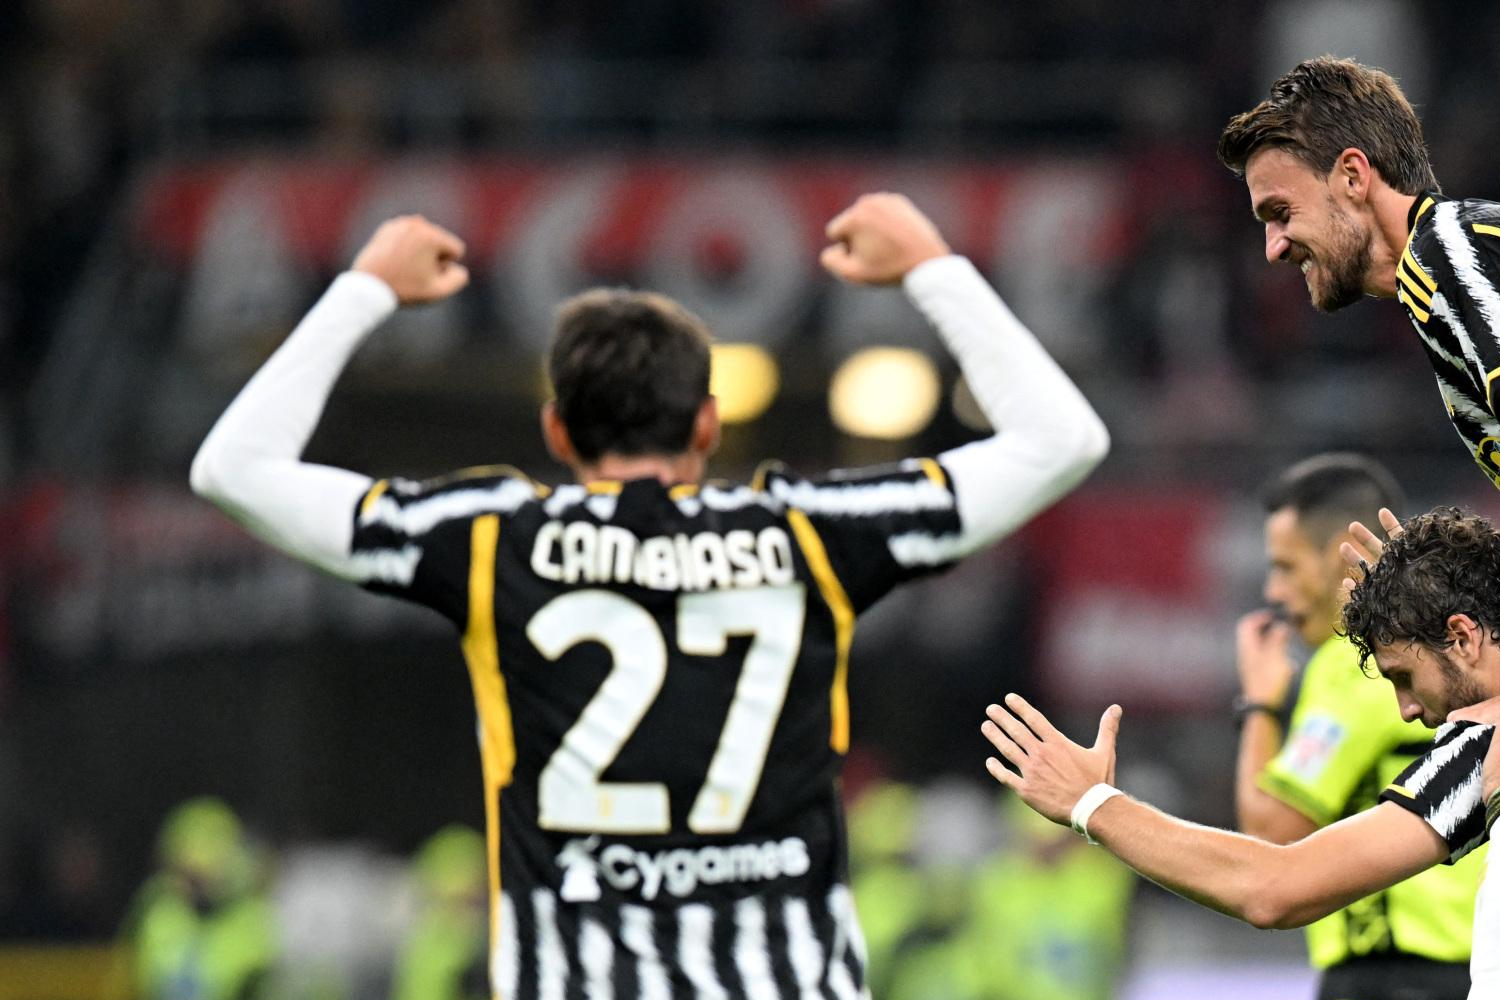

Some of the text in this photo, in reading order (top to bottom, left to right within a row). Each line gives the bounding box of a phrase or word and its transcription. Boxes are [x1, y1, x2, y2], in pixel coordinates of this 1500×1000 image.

[530, 519, 795, 592] CAMBIASO
[525, 581, 807, 835] 27
[600, 836, 811, 901] Cygames
